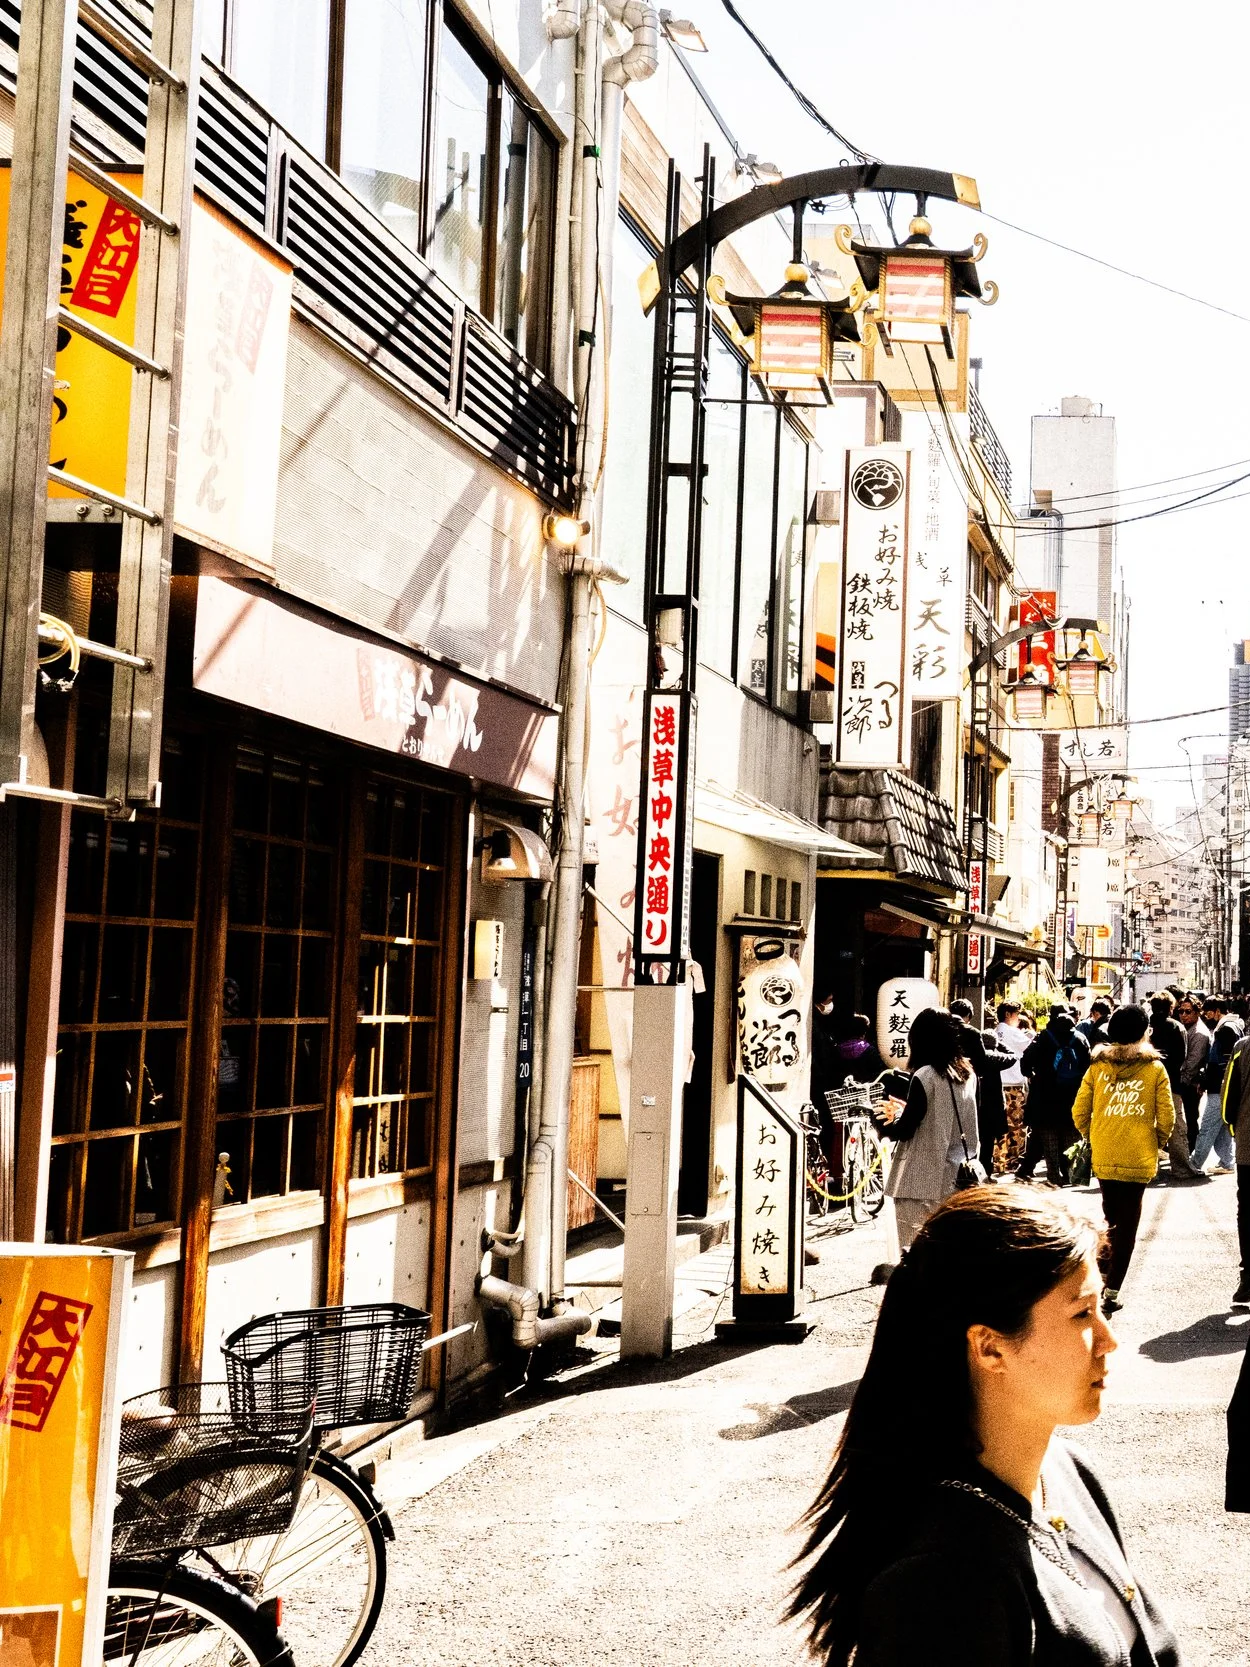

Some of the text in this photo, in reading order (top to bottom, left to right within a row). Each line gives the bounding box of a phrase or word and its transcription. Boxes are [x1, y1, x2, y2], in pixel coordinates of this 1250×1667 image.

[847, 572, 875, 641] 鉄板焼
[873, 524, 902, 612] お好み焼
[843, 696, 873, 744] 次郎
[644, 704, 676, 946] 浅草中央通り
[969, 865, 981, 971] 浅草中通り
[519, 1063, 530, 1078] 20
[750, 1019, 781, 1069] 次郎
[752, 1123, 781, 1291] お好み焼き
